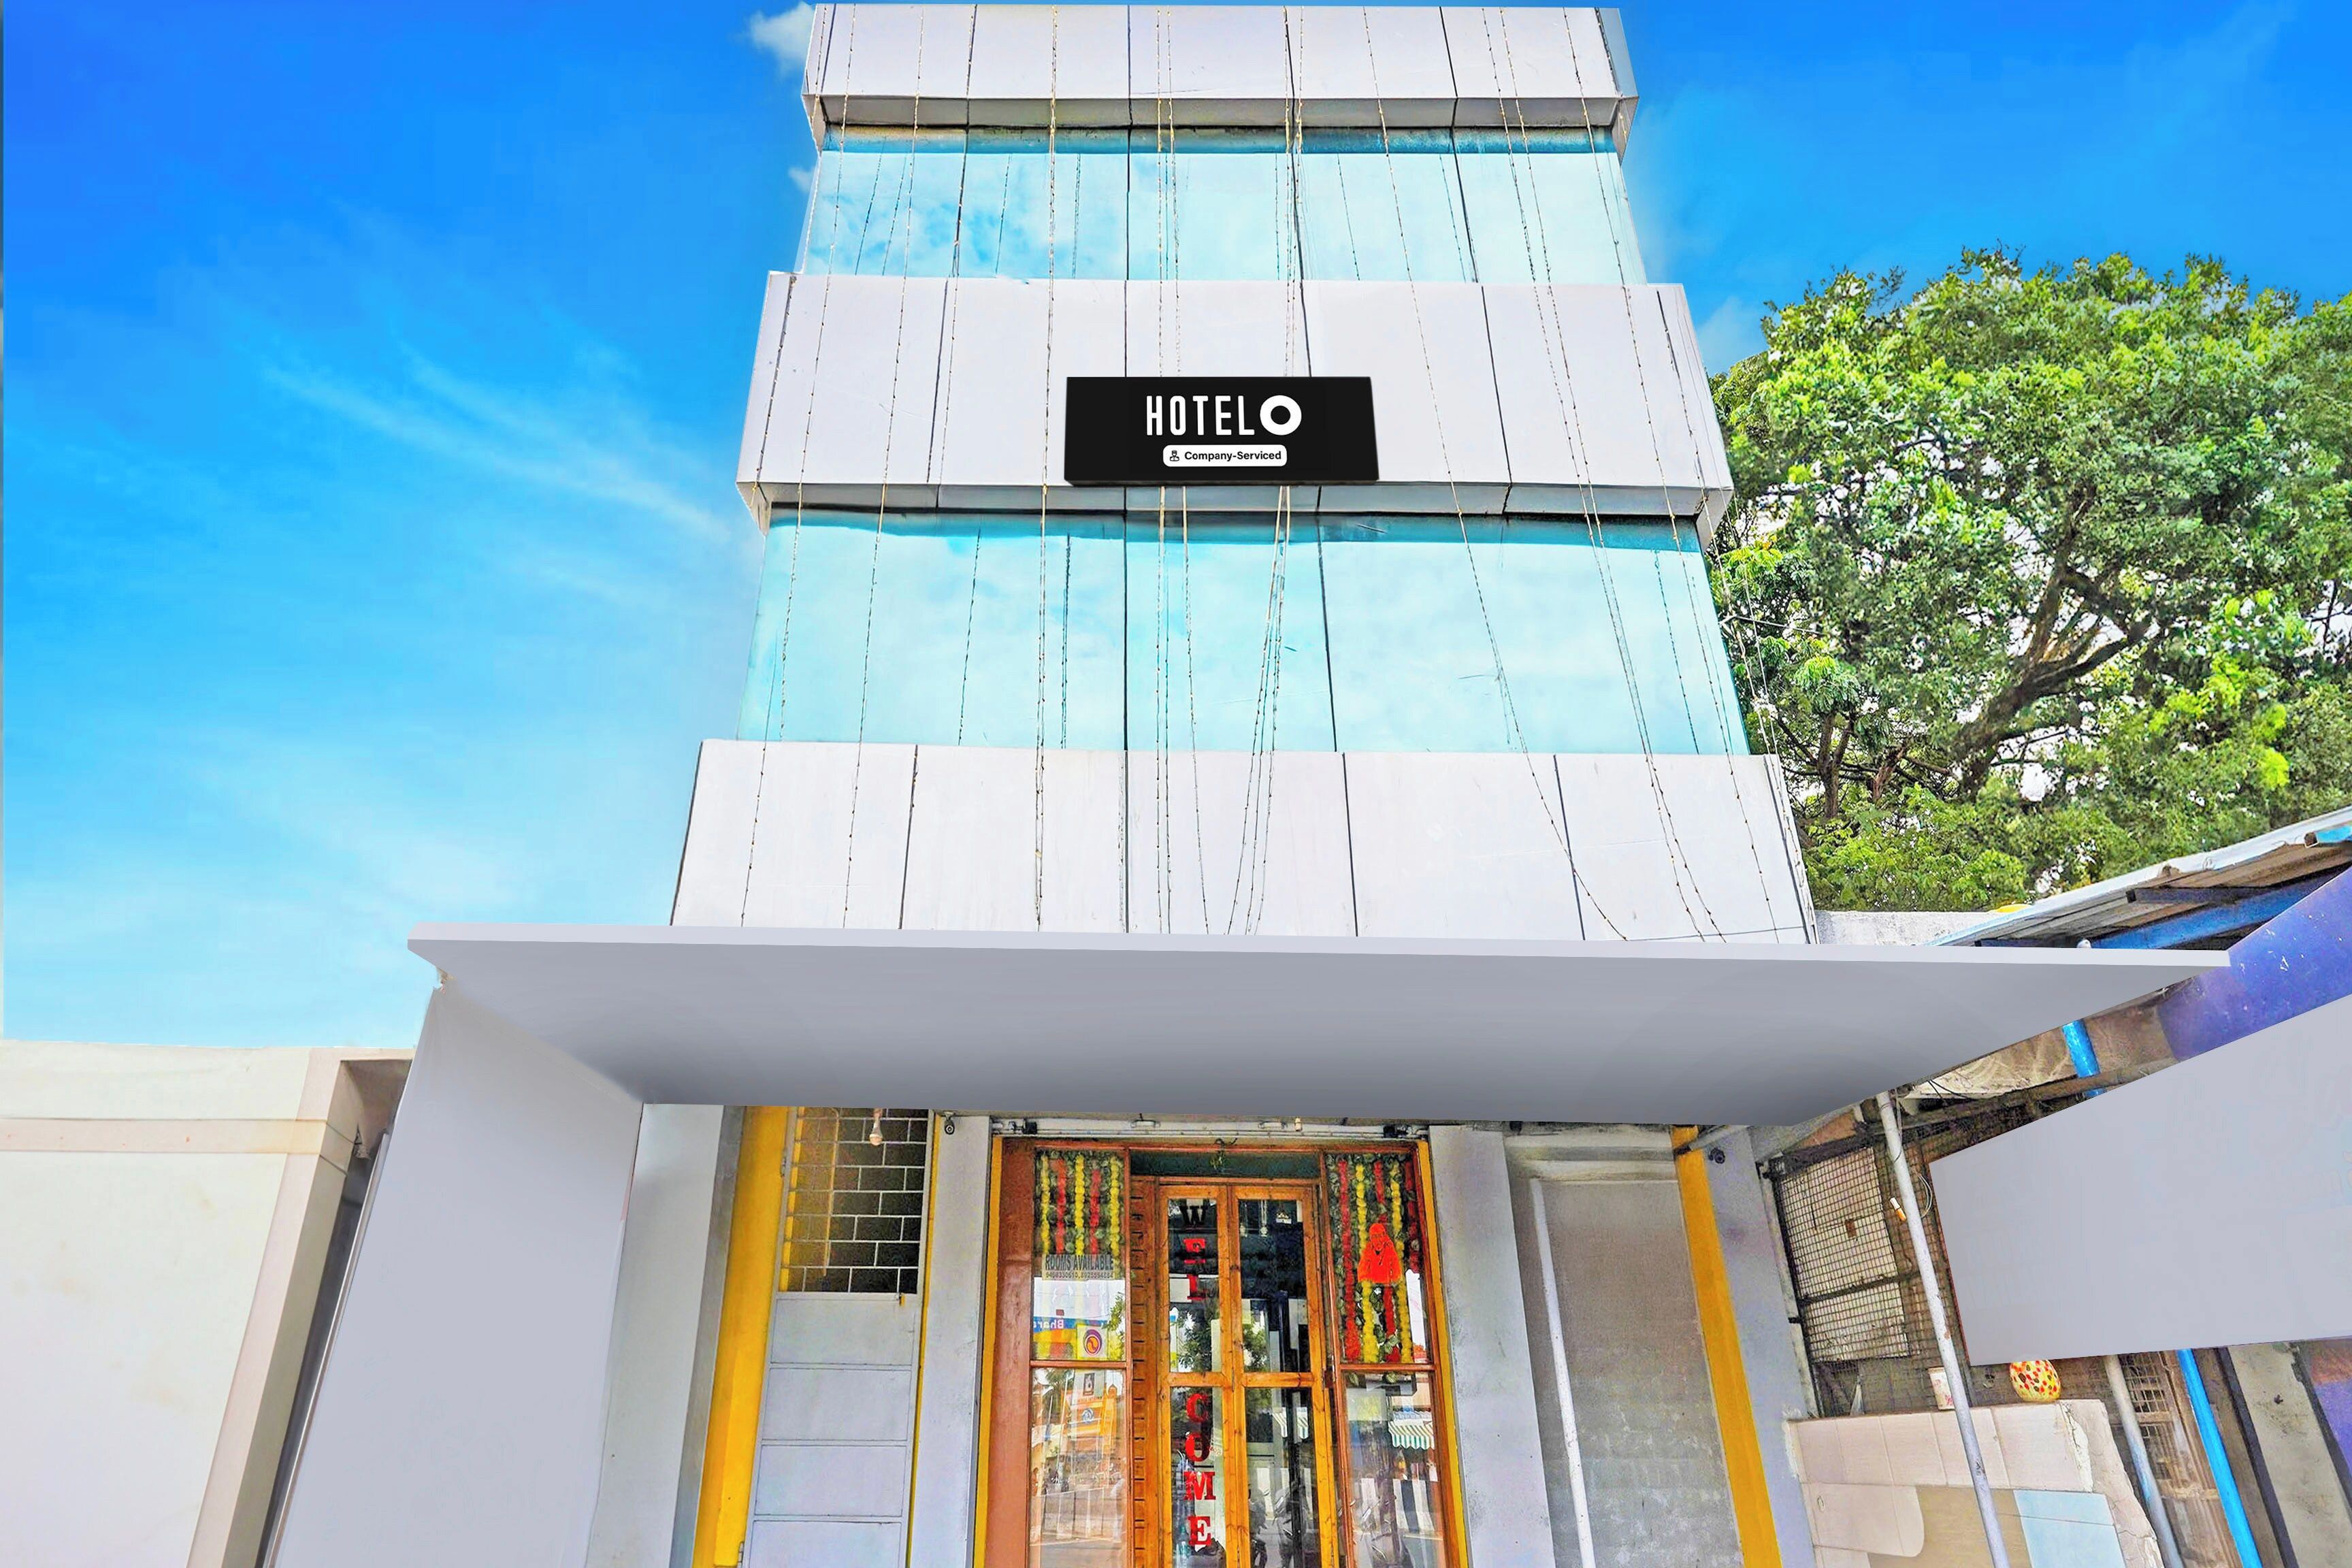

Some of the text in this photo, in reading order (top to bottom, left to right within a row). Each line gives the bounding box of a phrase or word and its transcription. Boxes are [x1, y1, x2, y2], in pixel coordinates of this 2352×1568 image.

[1146, 395, 1255, 436] HOTEL
[1184, 451, 1281, 462] Company-Serviced
[1045, 1254, 1114, 1271] ROOMS AVAILABLE
